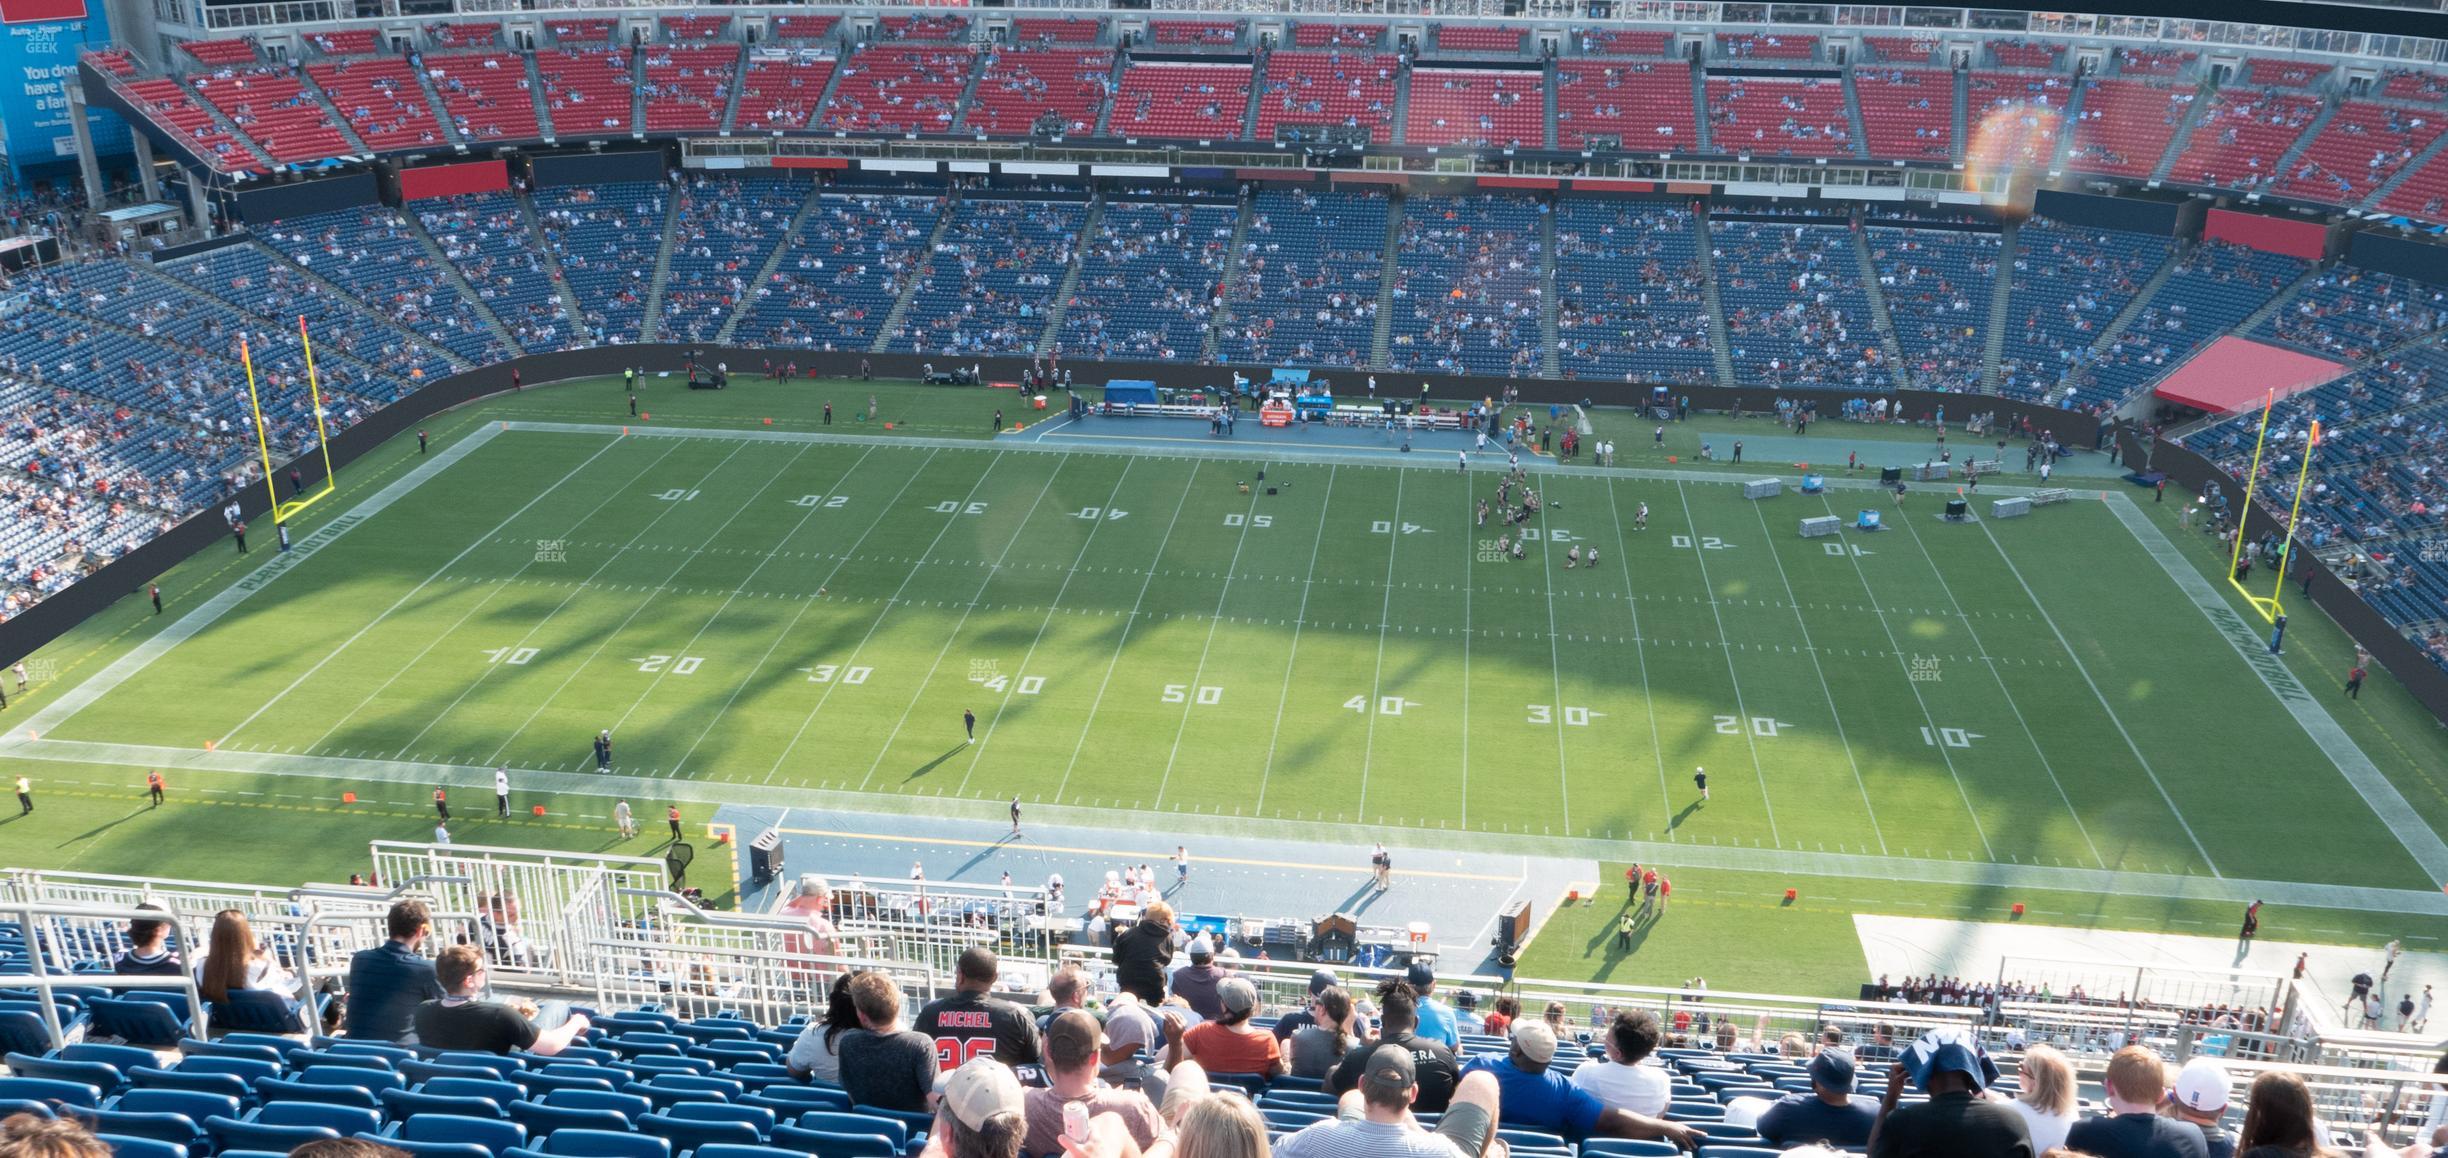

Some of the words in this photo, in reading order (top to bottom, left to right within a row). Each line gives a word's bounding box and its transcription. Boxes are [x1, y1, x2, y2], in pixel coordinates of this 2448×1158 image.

[38, 24, 63, 34] Home
[24, 66, 50, 80] You
[24, 81, 58, 96] have
[659, 489, 701, 501] 10
[796, 495, 849, 508] 20
[935, 501, 988, 514] 30
[1077, 507, 1129, 520] 40
[1222, 514, 1273, 528] 50
[1370, 520, 1421, 534] 40
[1521, 528, 1572, 542] 30
[1671, 535, 1723, 549] 20
[1822, 542, 1862, 556] 10
[489, 646, 541, 664] 10
[638, 655, 705, 674] 20
[808, 664, 874, 684] 30
[983, 675, 1046, 694] 40
[1161, 684, 1223, 705] 50
[1343, 695, 1404, 715] 40
[1527, 704, 1589, 726] 30
[1713, 715, 1778, 736] 20
[1920, 727, 1971, 748] 10
[938, 1011, 992, 1028] MICHEL
